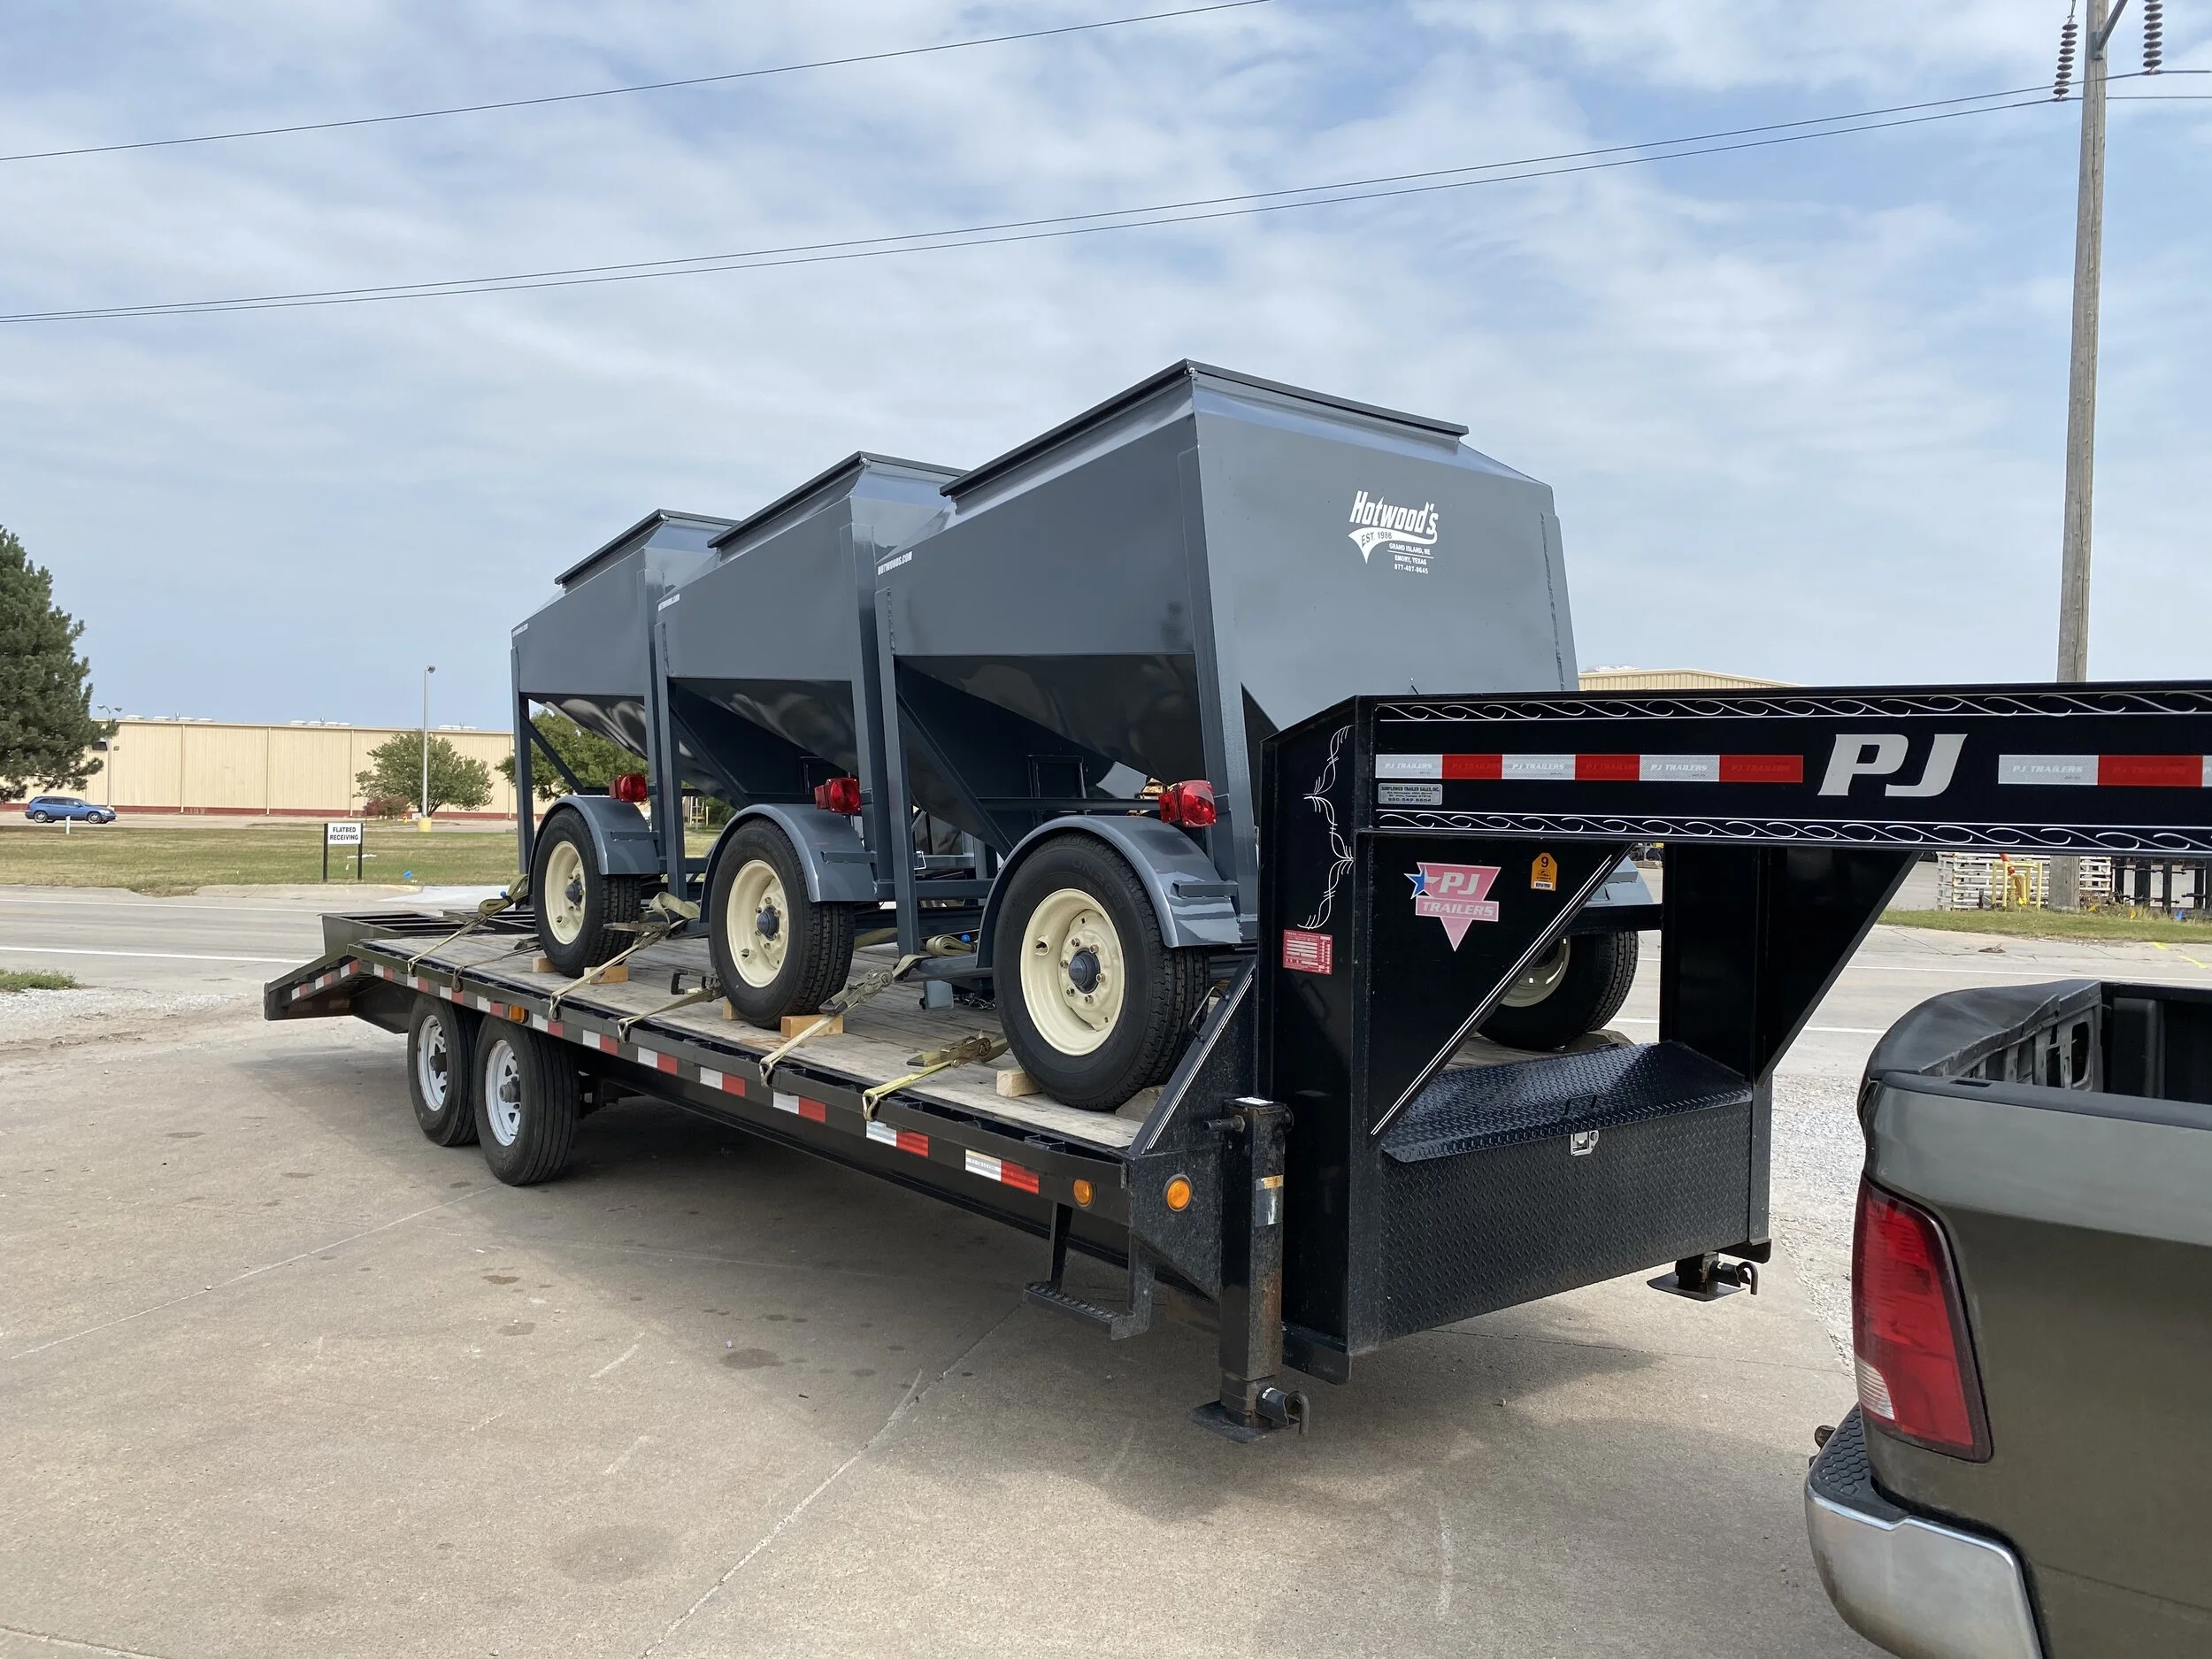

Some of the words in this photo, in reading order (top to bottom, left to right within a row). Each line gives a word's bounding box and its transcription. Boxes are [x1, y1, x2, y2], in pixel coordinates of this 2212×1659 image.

[1349, 490, 1439, 534] Hotwood's
[1406, 546, 1424, 555] ISLAND,
[1394, 555, 1411, 564] EMORY,
[1817, 733, 1968, 796] PJ
[1540, 856, 1549, 868] 9
[1439, 872, 1480, 895] PJ
[1422, 902, 1494, 917] TRAILERS
